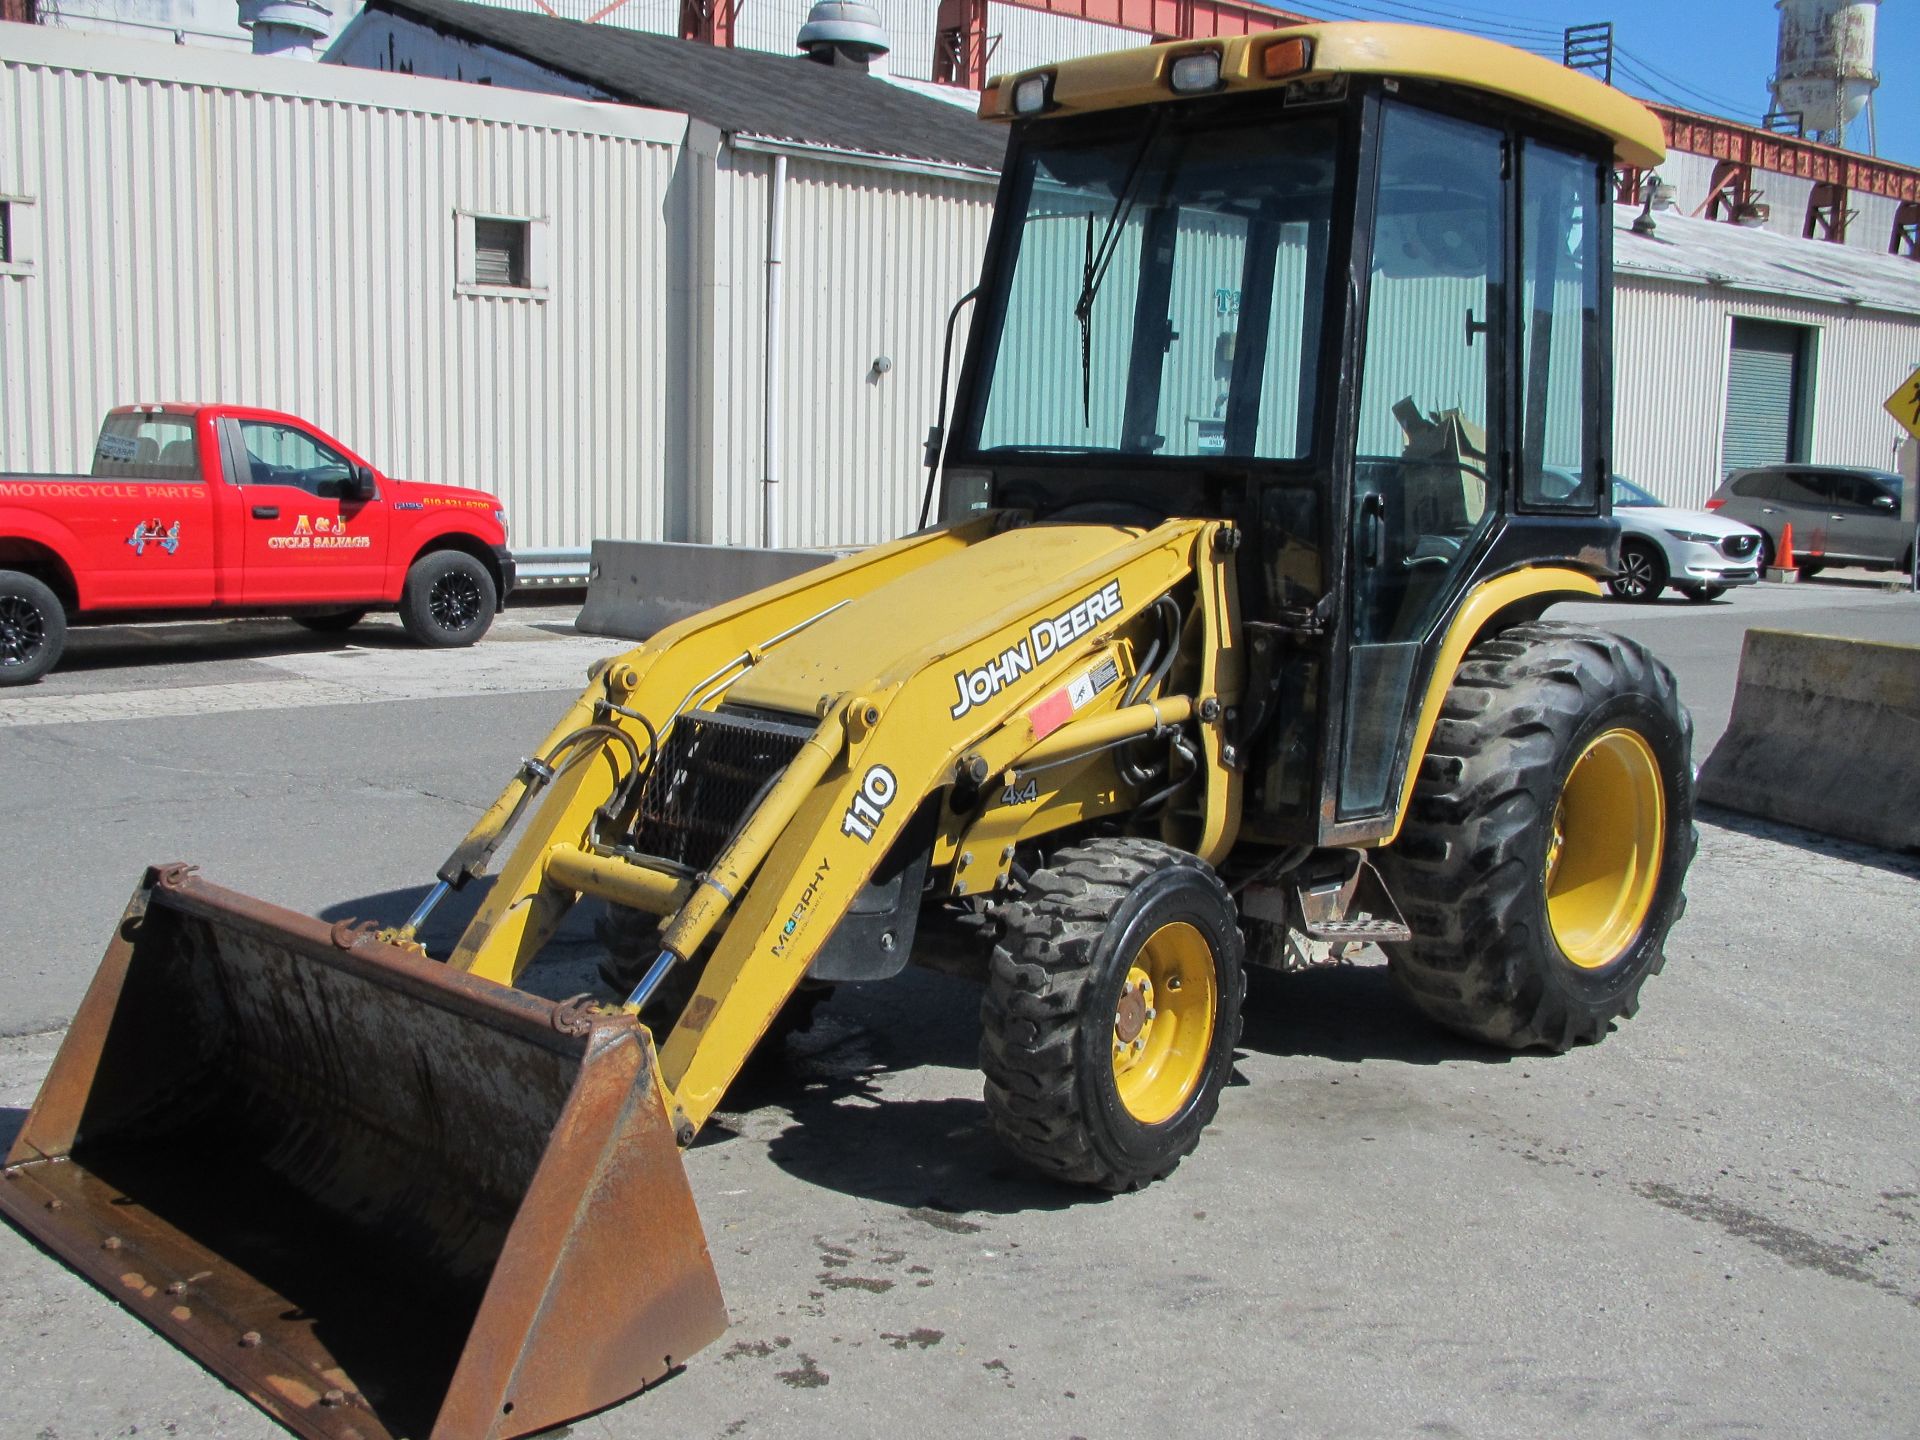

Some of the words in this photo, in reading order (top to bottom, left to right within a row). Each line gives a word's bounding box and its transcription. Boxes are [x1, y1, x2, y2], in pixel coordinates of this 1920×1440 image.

[0, 483, 139, 498] MOTORCYCLE
[145, 485, 205, 499] PARTS
[293, 514, 314, 535] A
[315, 517, 330, 532] &
[332, 515, 347, 535] J
[267, 537, 311, 549] CYCLE
[313, 536, 371, 548] SALVAGE
[950, 638, 1033, 720] JOHN
[1029, 579, 1123, 664] DEERE
[839, 763, 898, 845] 110
[1001, 780, 1038, 806] 4x4
